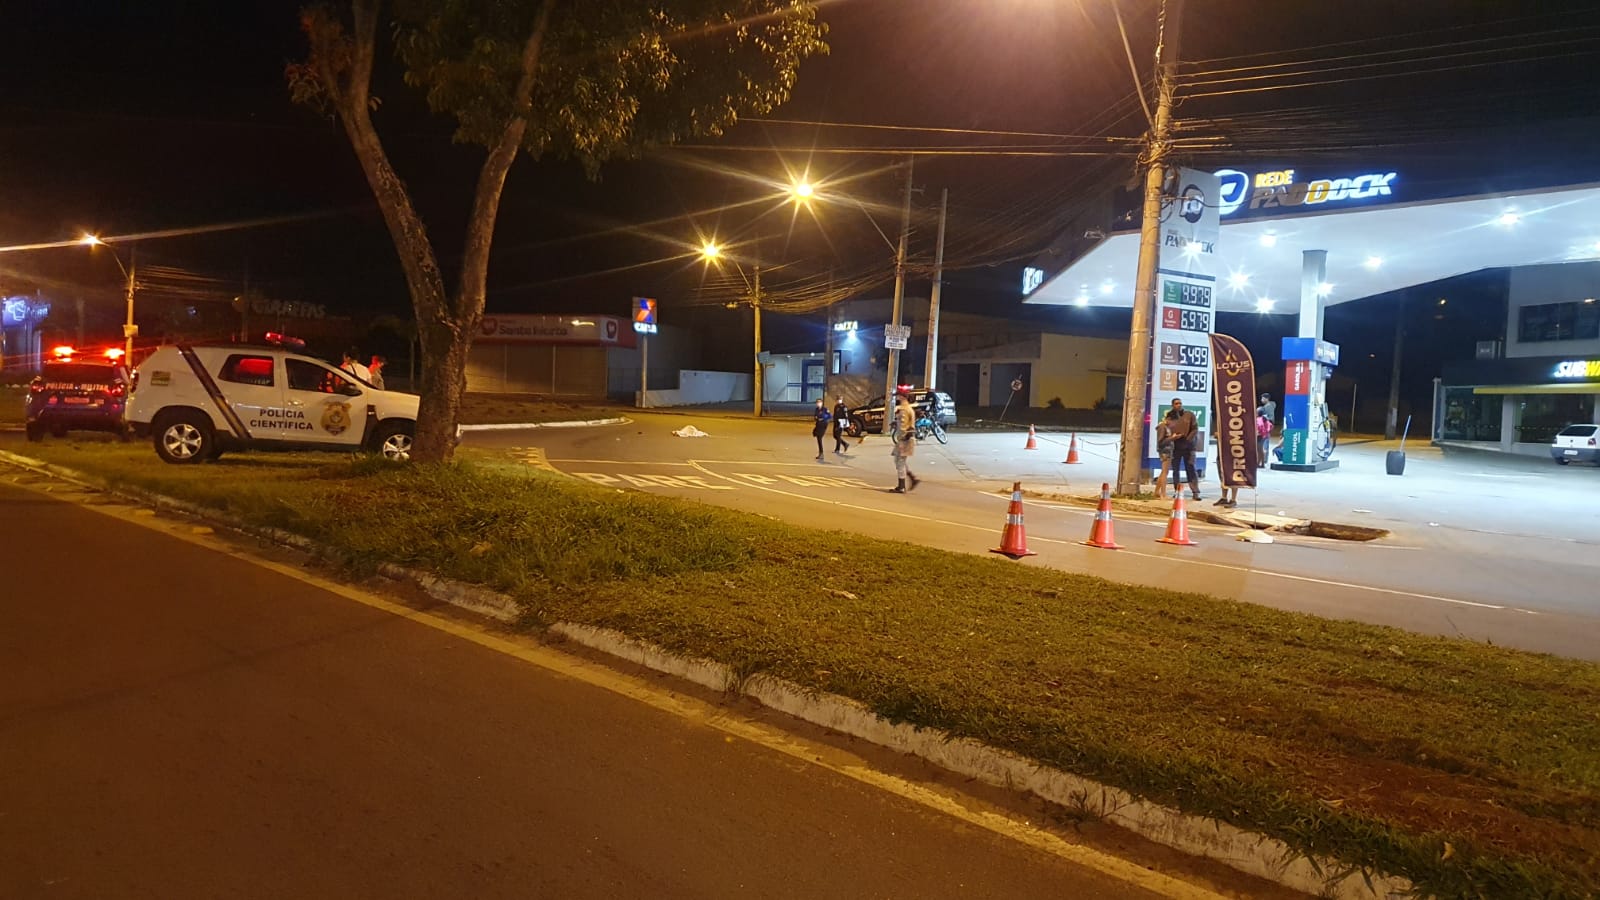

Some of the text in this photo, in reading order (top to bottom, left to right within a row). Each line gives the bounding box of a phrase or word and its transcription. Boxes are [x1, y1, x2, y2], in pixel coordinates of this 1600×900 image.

[1255, 170, 1295, 188] REDE
[1249, 172, 1397, 209] PADDOCK
[1168, 310, 1174, 319] G
[1181, 310, 1209, 332] 6.979
[1166, 345, 1172, 354] D
[1179, 345, 1208, 366] 5.499
[1216, 361, 1250, 370] LOTUS
[1178, 372, 1208, 392] 5.799
[259, 408, 305, 419] POLÍCIA
[249, 419, 313, 430] CIENTÍFICA
[1224, 380, 1247, 482] PROMOÇÃO
